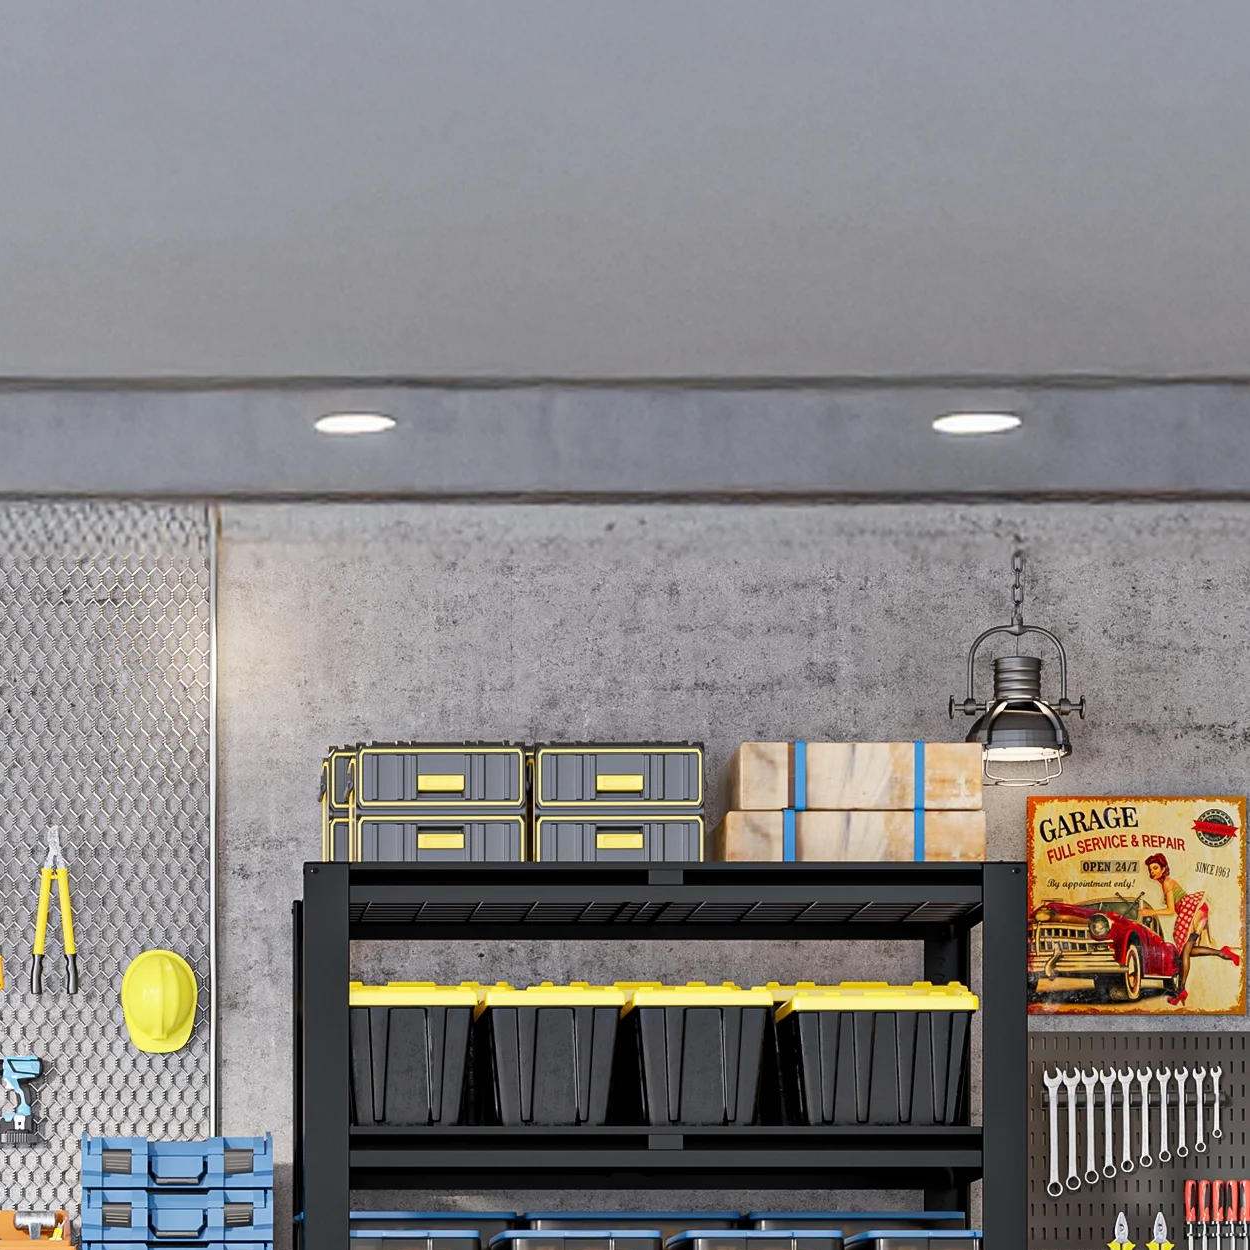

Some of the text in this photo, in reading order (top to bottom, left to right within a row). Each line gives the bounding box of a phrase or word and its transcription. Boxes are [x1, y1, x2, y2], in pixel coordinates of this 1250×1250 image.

[1039, 806, 1139, 843] GARAGE
[1047, 834, 1186, 864] FULL SERVICE & REPAIR
[1082, 861, 1138, 872] OPEN 24/7
[1195, 861, 1231, 879] SINCE 1963
[1047, 878, 1136, 890] By appointment only!
